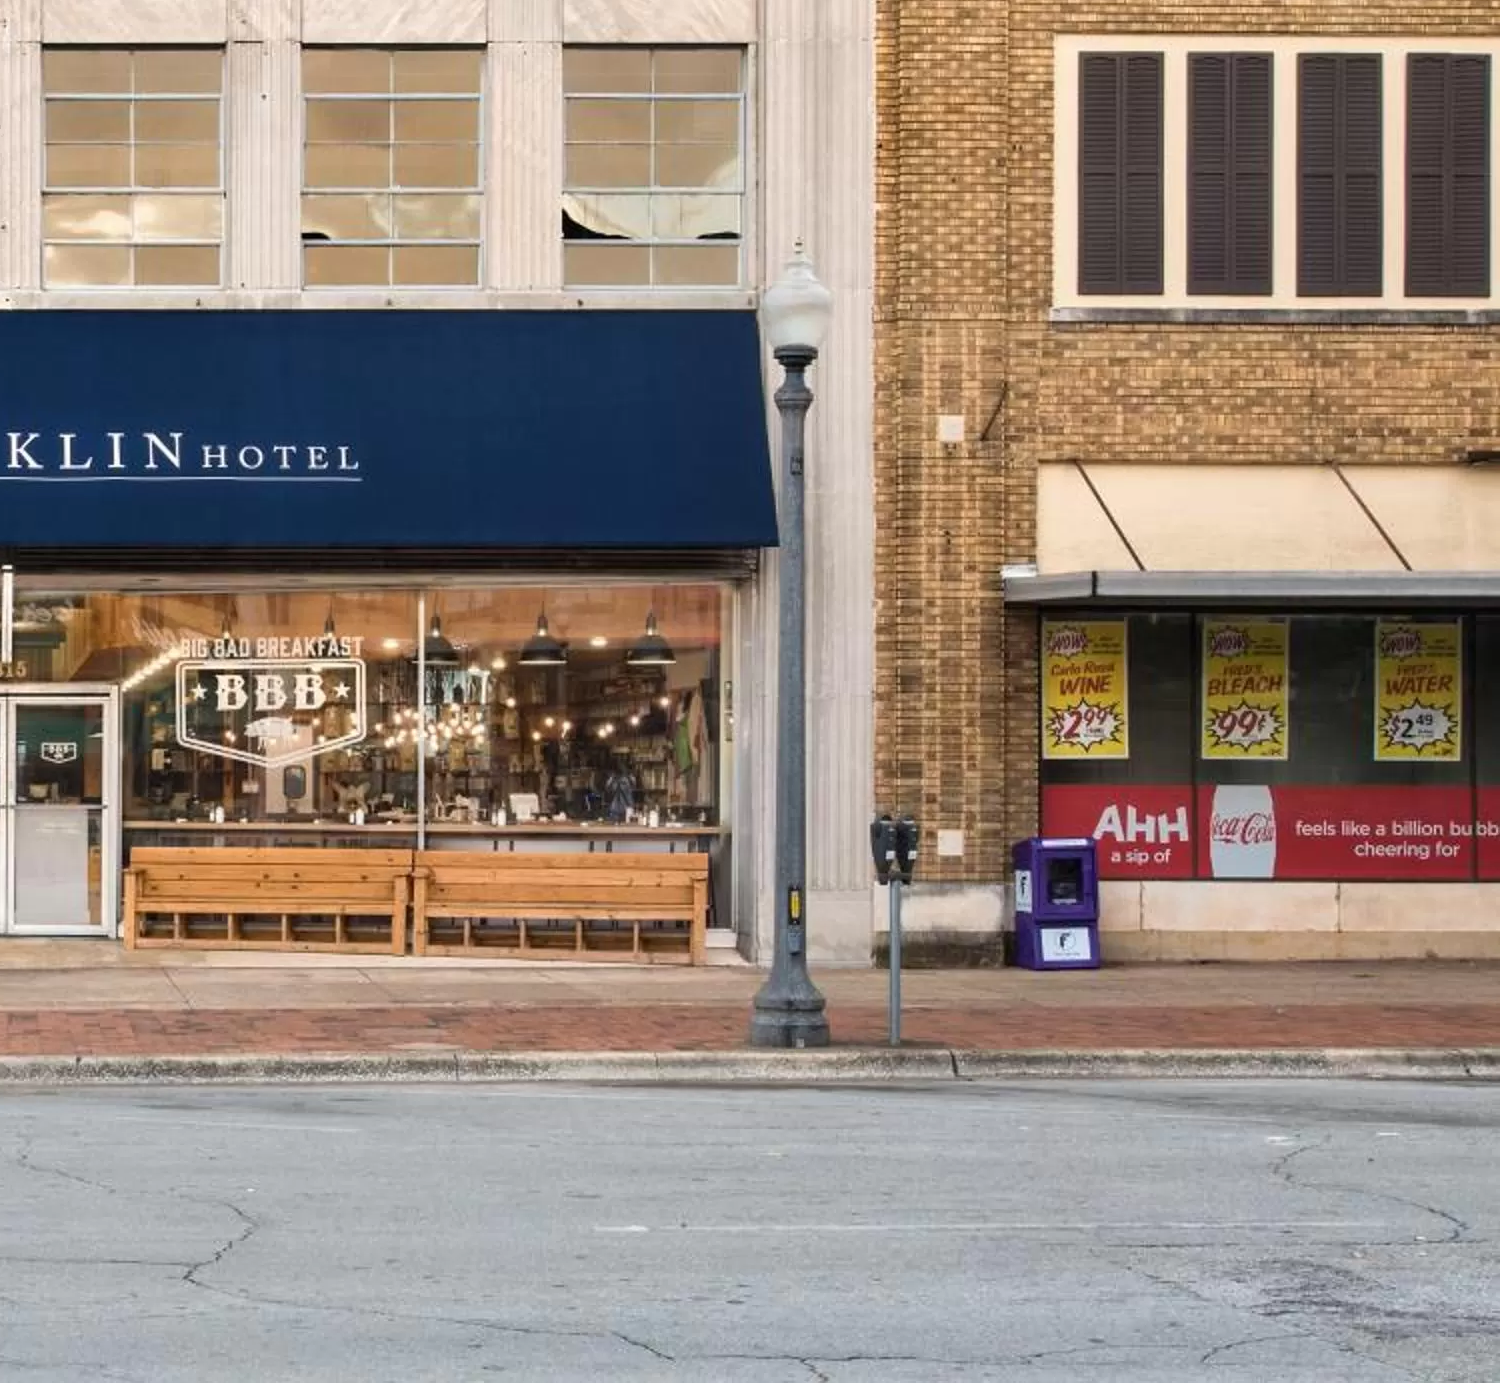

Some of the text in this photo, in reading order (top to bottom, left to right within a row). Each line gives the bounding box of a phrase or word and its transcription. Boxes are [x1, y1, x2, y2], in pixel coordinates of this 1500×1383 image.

[201, 445, 361, 470] HOTEL
[181, 636, 365, 658] BIG BAD BREAKFAST
[215, 674, 327, 711] BBB
[1060, 675, 1112, 695] WINE
[1207, 675, 1283, 696] BLEACH
[1385, 674, 1453, 695] WATER
[1295, 820, 1336, 837] feels
[1341, 820, 1371, 837] like
[1375, 823, 1386, 837] a
[1391, 820, 1444, 837] billion
[1111, 848, 1173, 866] a sip of
[1354, 840, 1461, 860] cheering for
